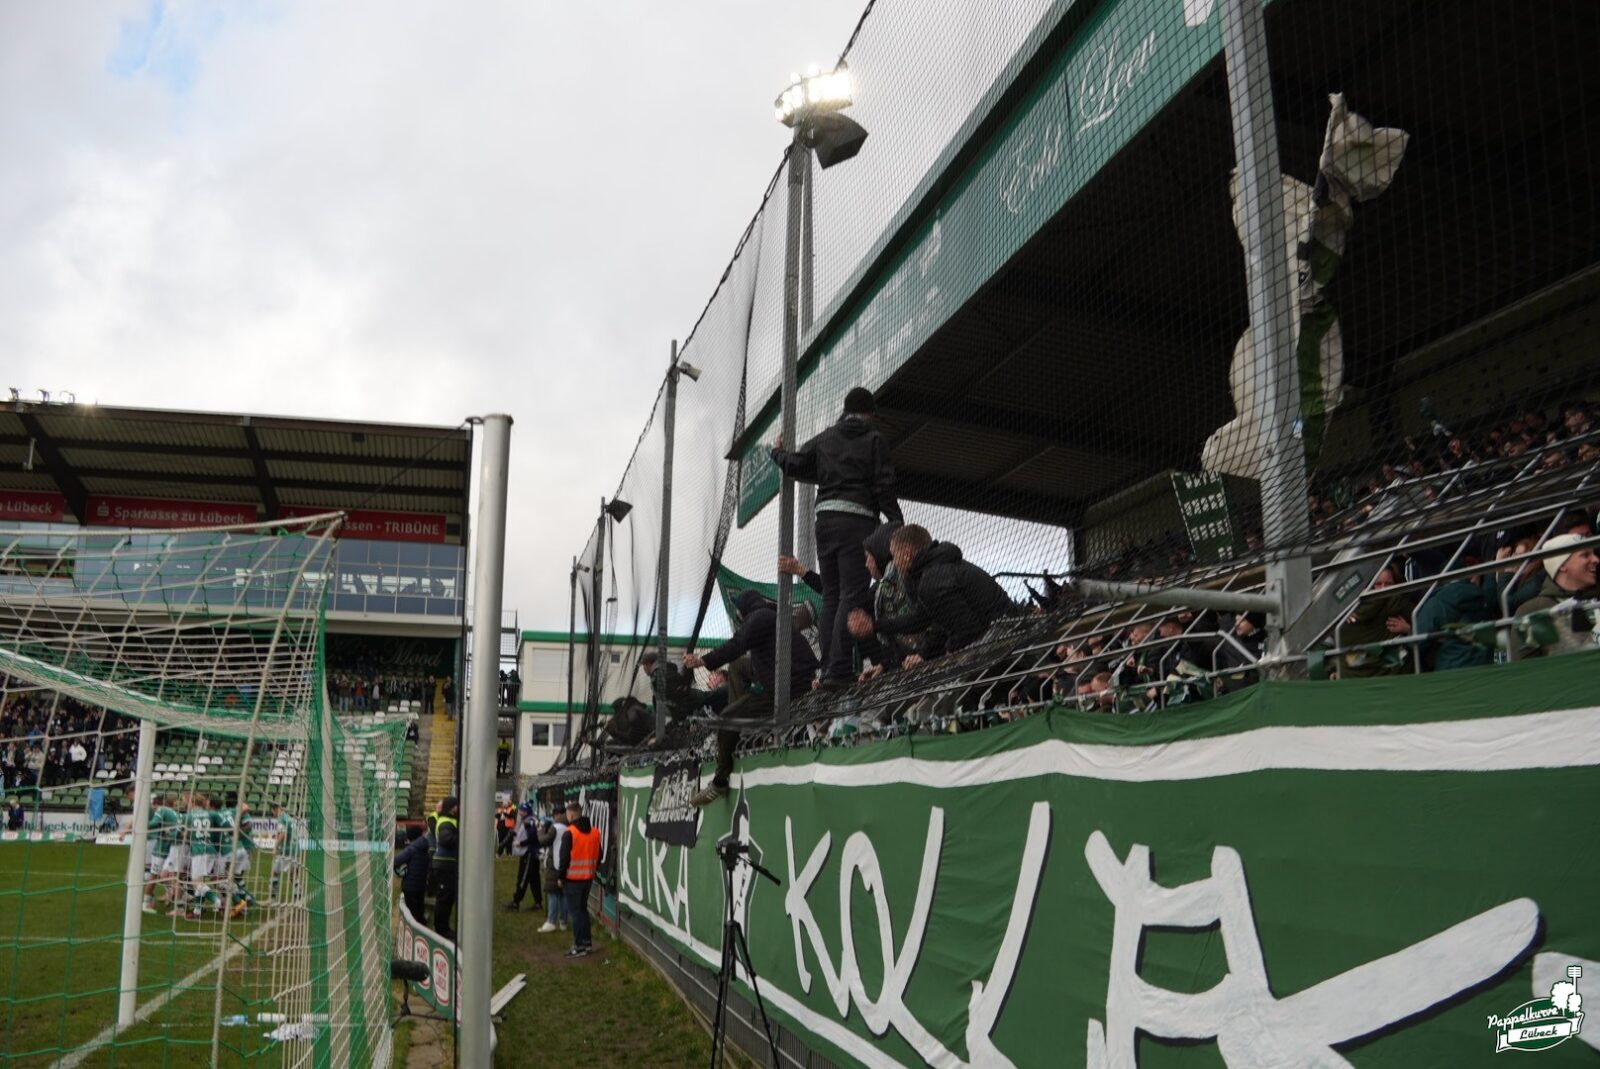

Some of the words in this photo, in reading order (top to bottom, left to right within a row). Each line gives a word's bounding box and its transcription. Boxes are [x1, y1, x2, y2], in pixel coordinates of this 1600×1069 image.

[7, 502, 53, 514] Lübeck
[114, 506, 178, 522] Sparkasse
[182, 512, 196, 523] zu
[200, 510, 245, 525] Lübeck
[384, 520, 440, 536] TRIBÜNE
[193, 818, 211, 838] 22
